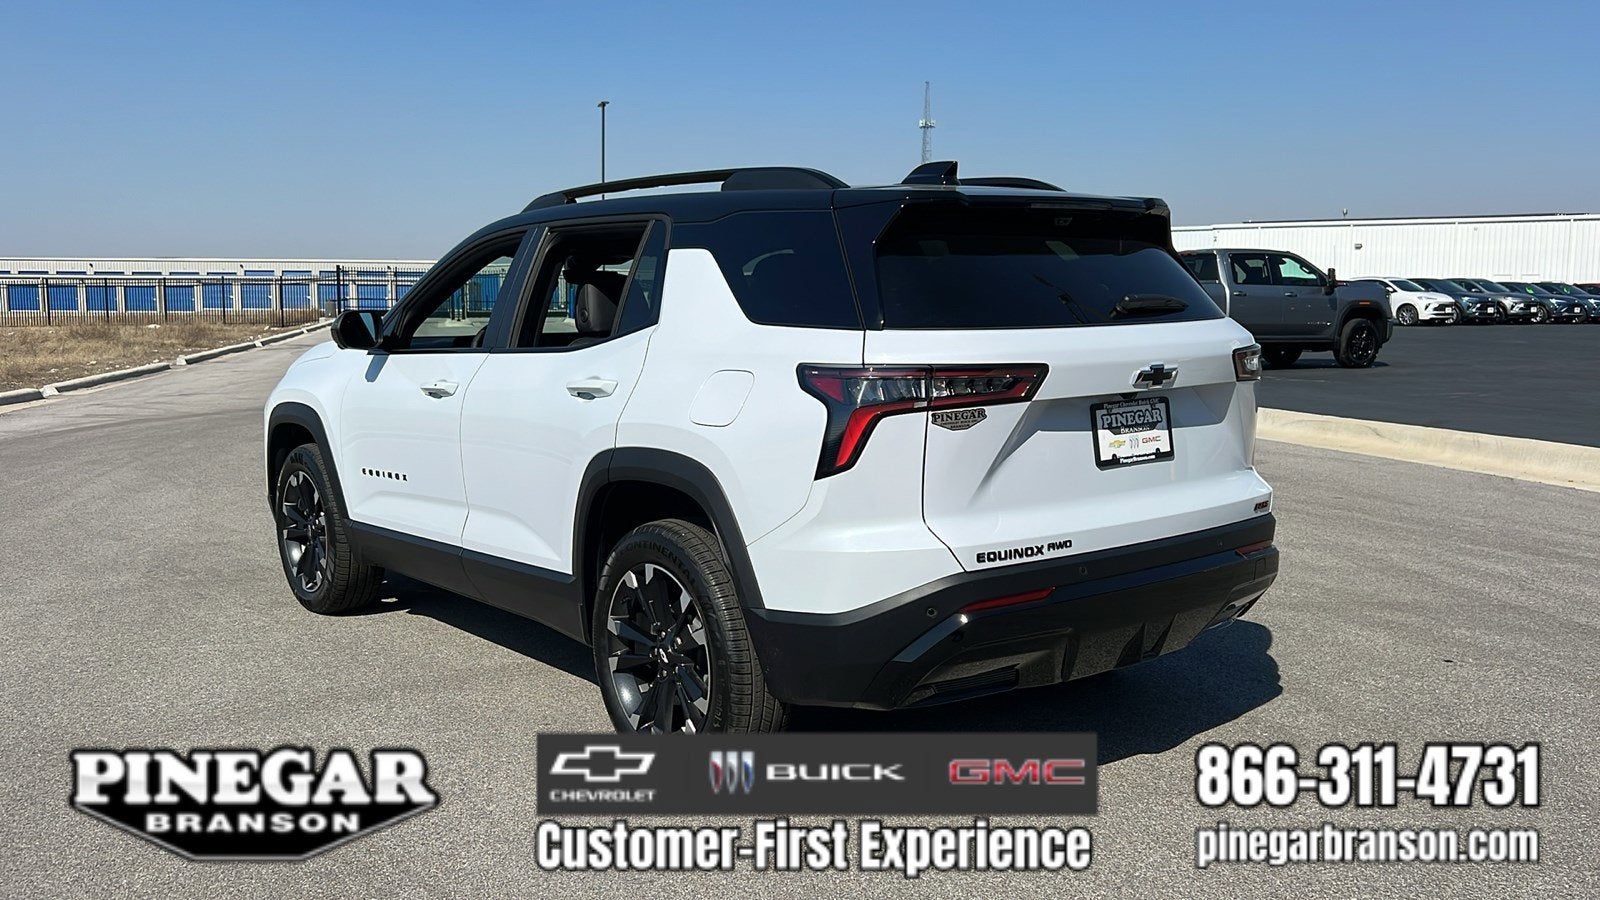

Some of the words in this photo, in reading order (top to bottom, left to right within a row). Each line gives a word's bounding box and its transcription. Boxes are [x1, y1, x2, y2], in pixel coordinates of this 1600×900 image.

[933, 410, 985, 422] PINEGAR
[1102, 409, 1162, 428] PINEGAR
[1141, 435, 1161, 444] GMC
[361, 467, 408, 482] EQUINOX
[976, 545, 1044, 564] EQUINOX
[1047, 539, 1073, 552] AWD
